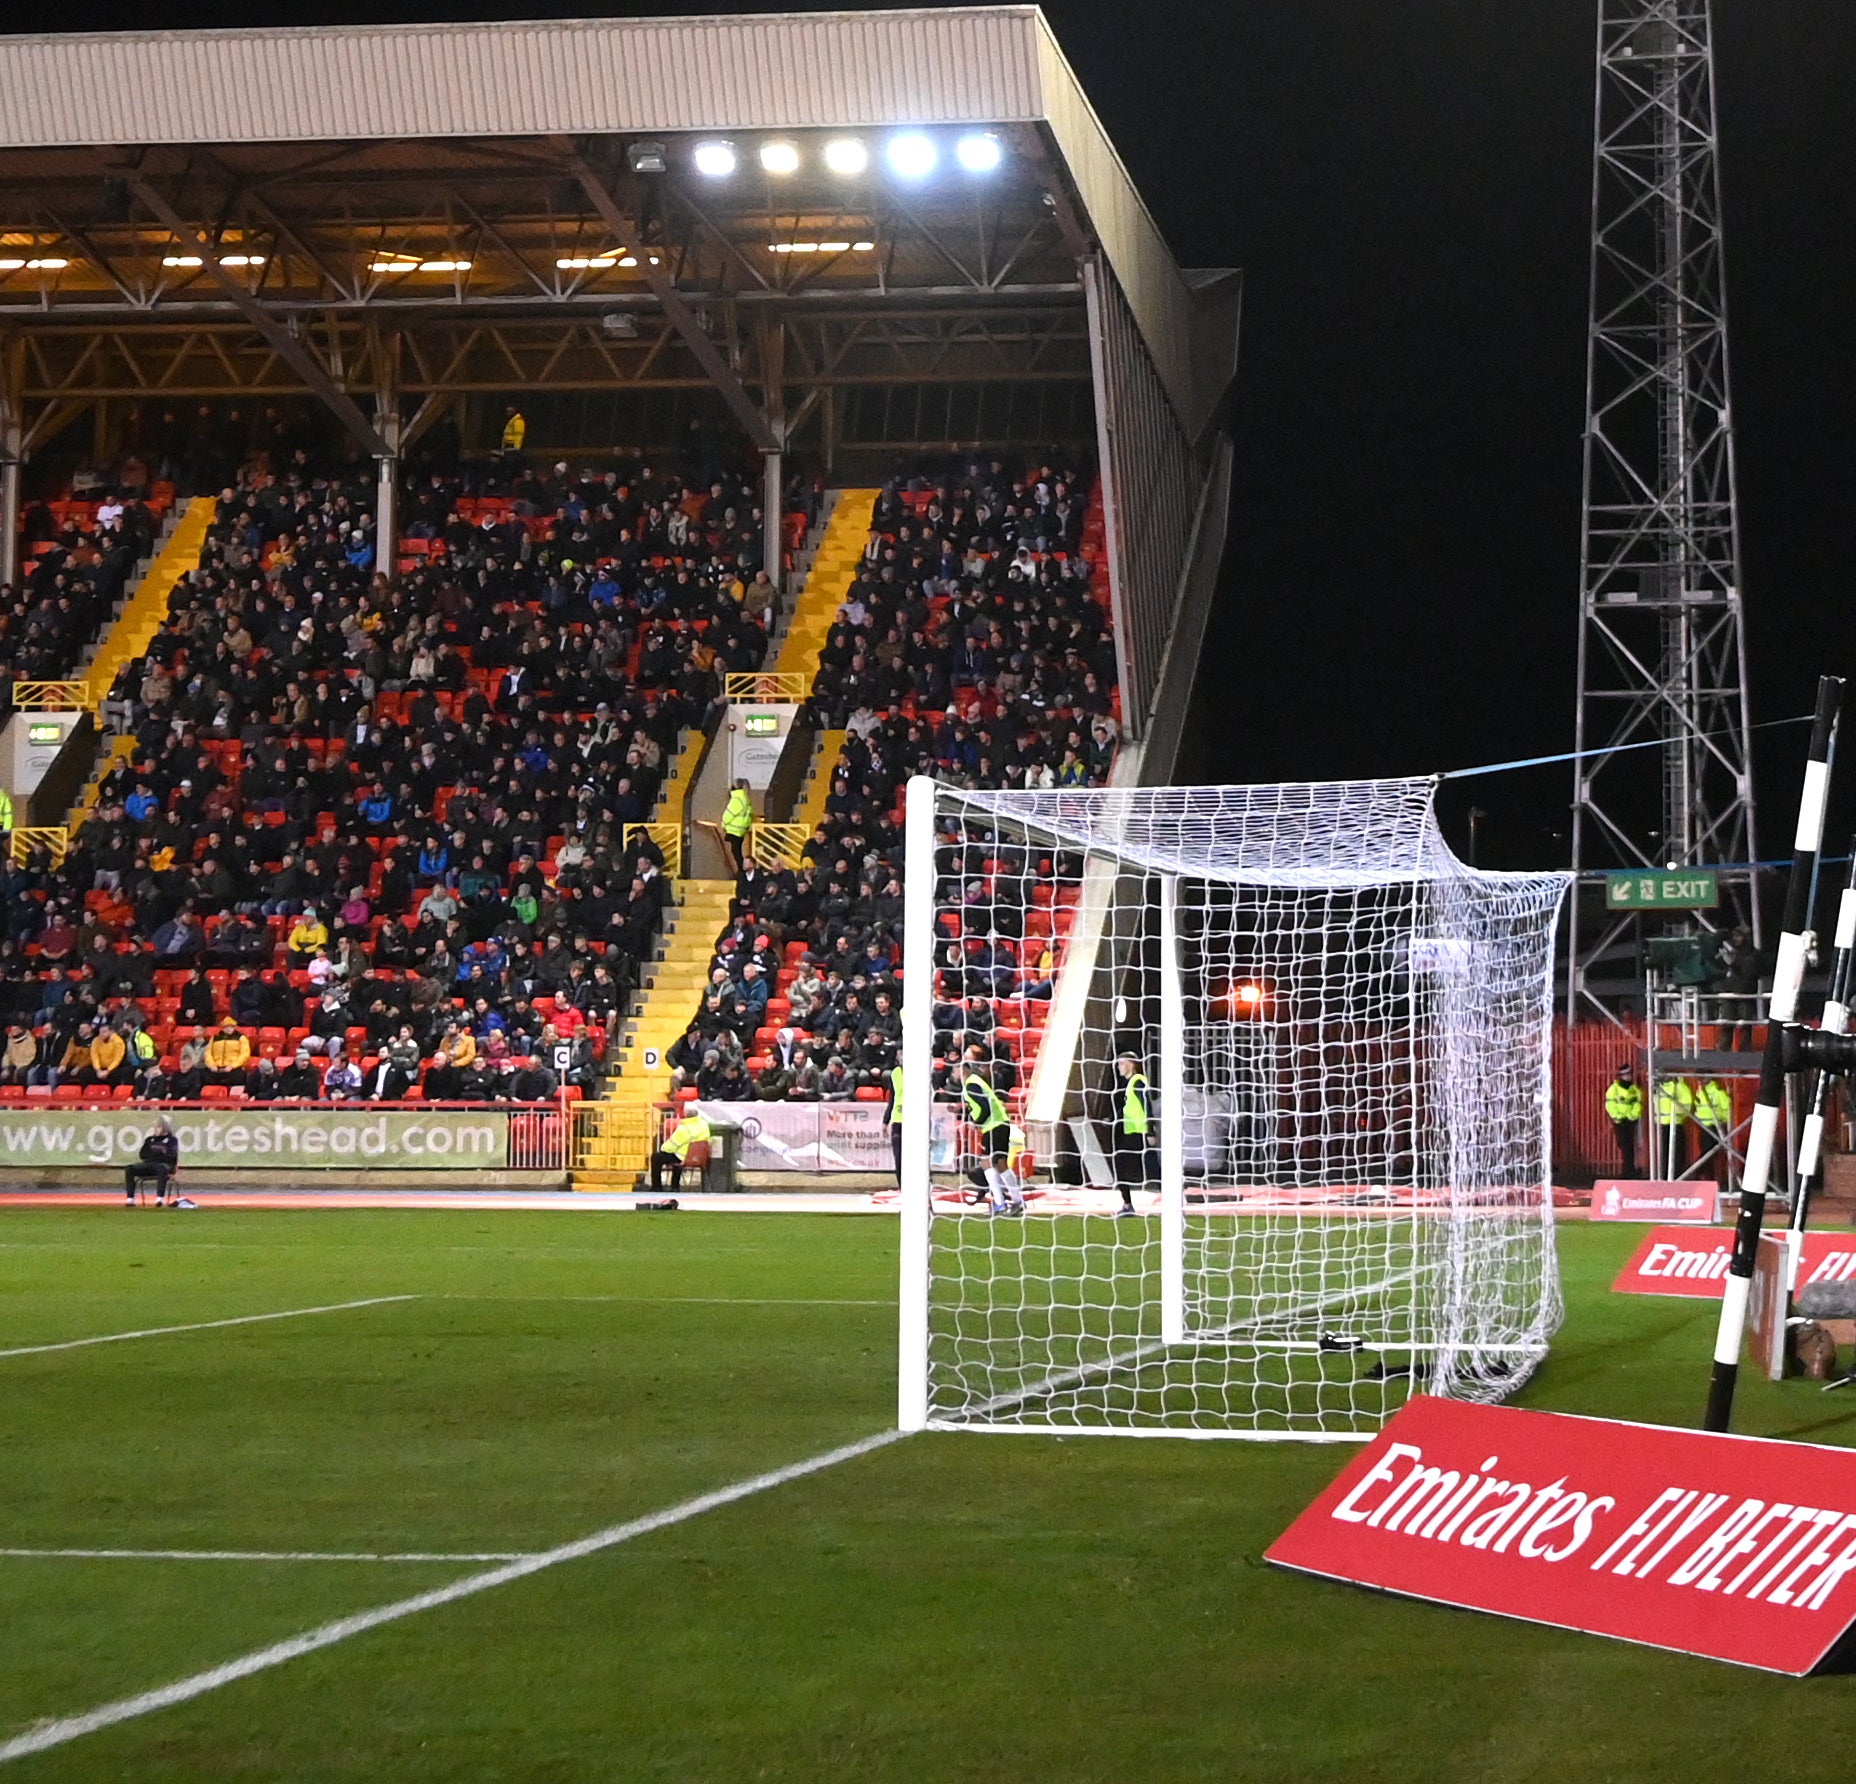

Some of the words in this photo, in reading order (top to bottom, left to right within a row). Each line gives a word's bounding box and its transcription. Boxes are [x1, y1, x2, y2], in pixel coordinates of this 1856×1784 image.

[1662, 880, 1710, 898] EXIT
[556, 1051, 568, 1064] C
[645, 1051, 657, 1065] D
[826, 1129, 854, 1139] More
[855, 1129, 880, 1139] than
[1662, 1197, 1676, 1209] FA
[1677, 1197, 1703, 1209] CUP
[1331, 1442, 1616, 1563] Emirates
[1590, 1487, 1731, 1579] FLY
